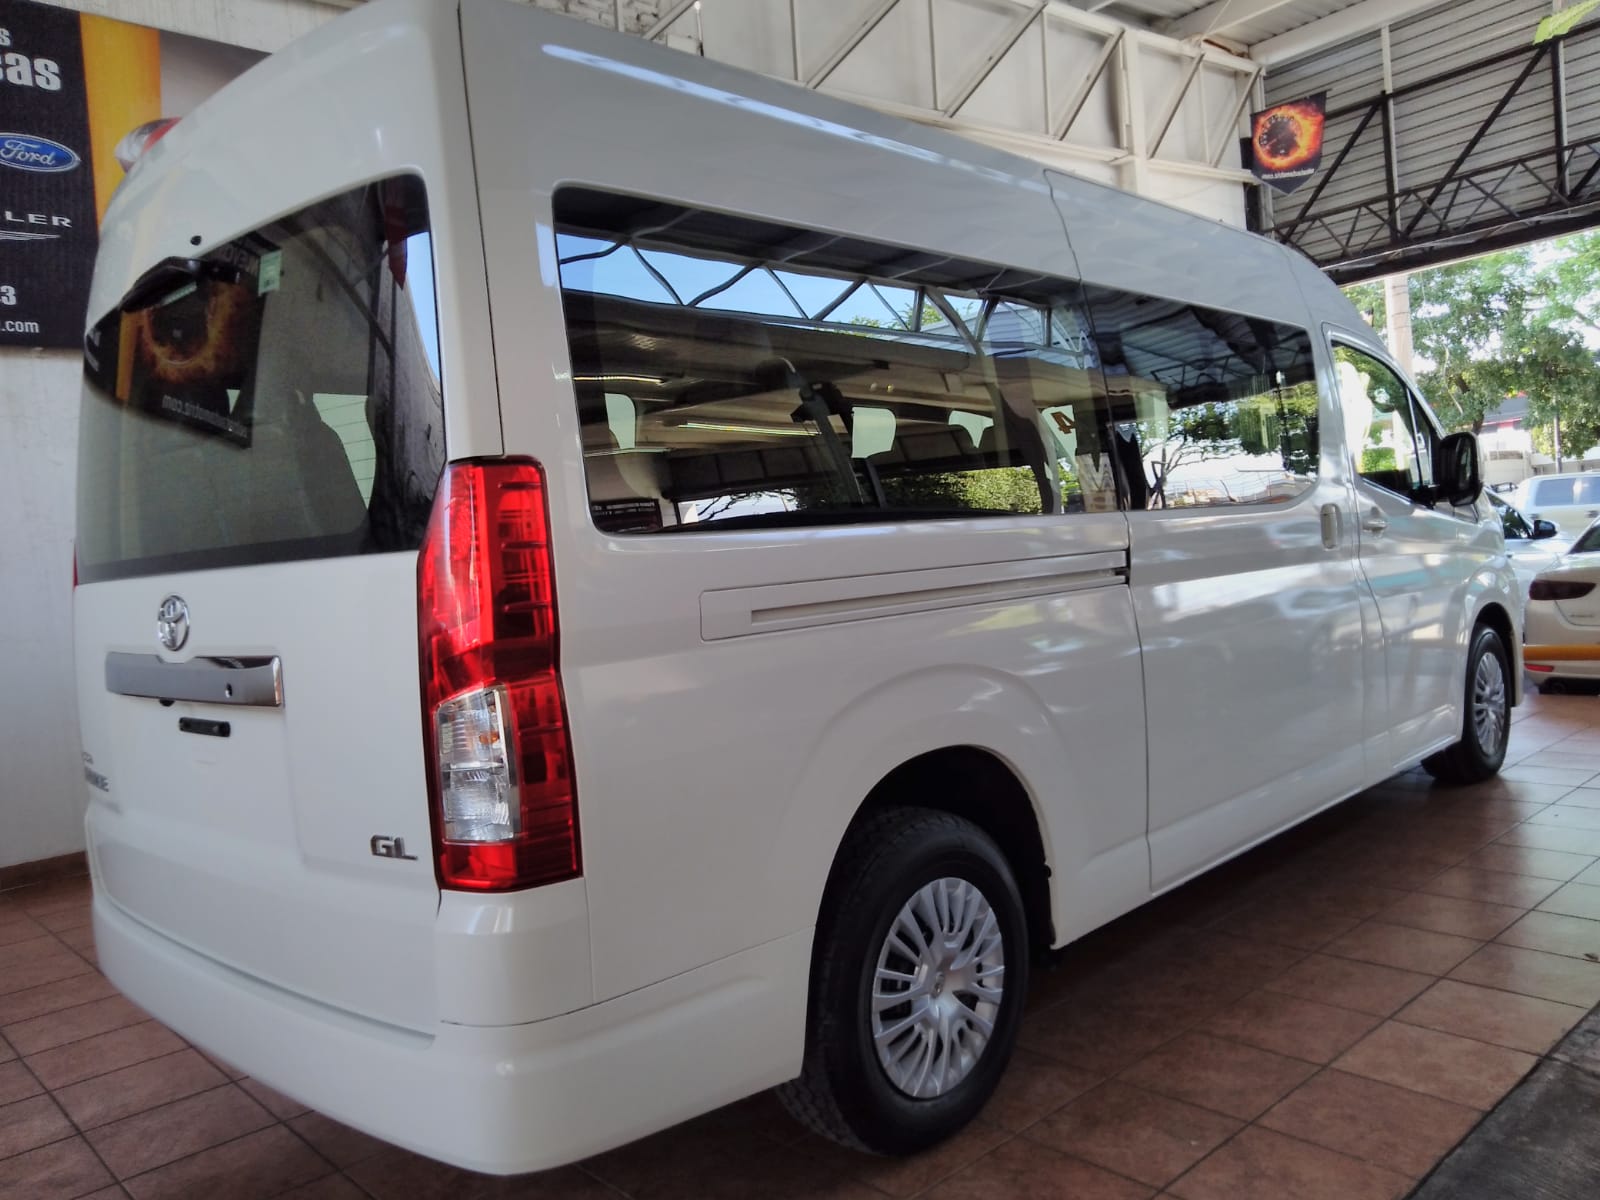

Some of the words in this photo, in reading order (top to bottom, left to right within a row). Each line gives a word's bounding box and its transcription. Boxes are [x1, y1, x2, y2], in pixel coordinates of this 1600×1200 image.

[0, 52, 61, 91] as
[0, 138, 56, 166] Ford
[5, 211, 72, 228] LER
[370, 834, 419, 861] GL
